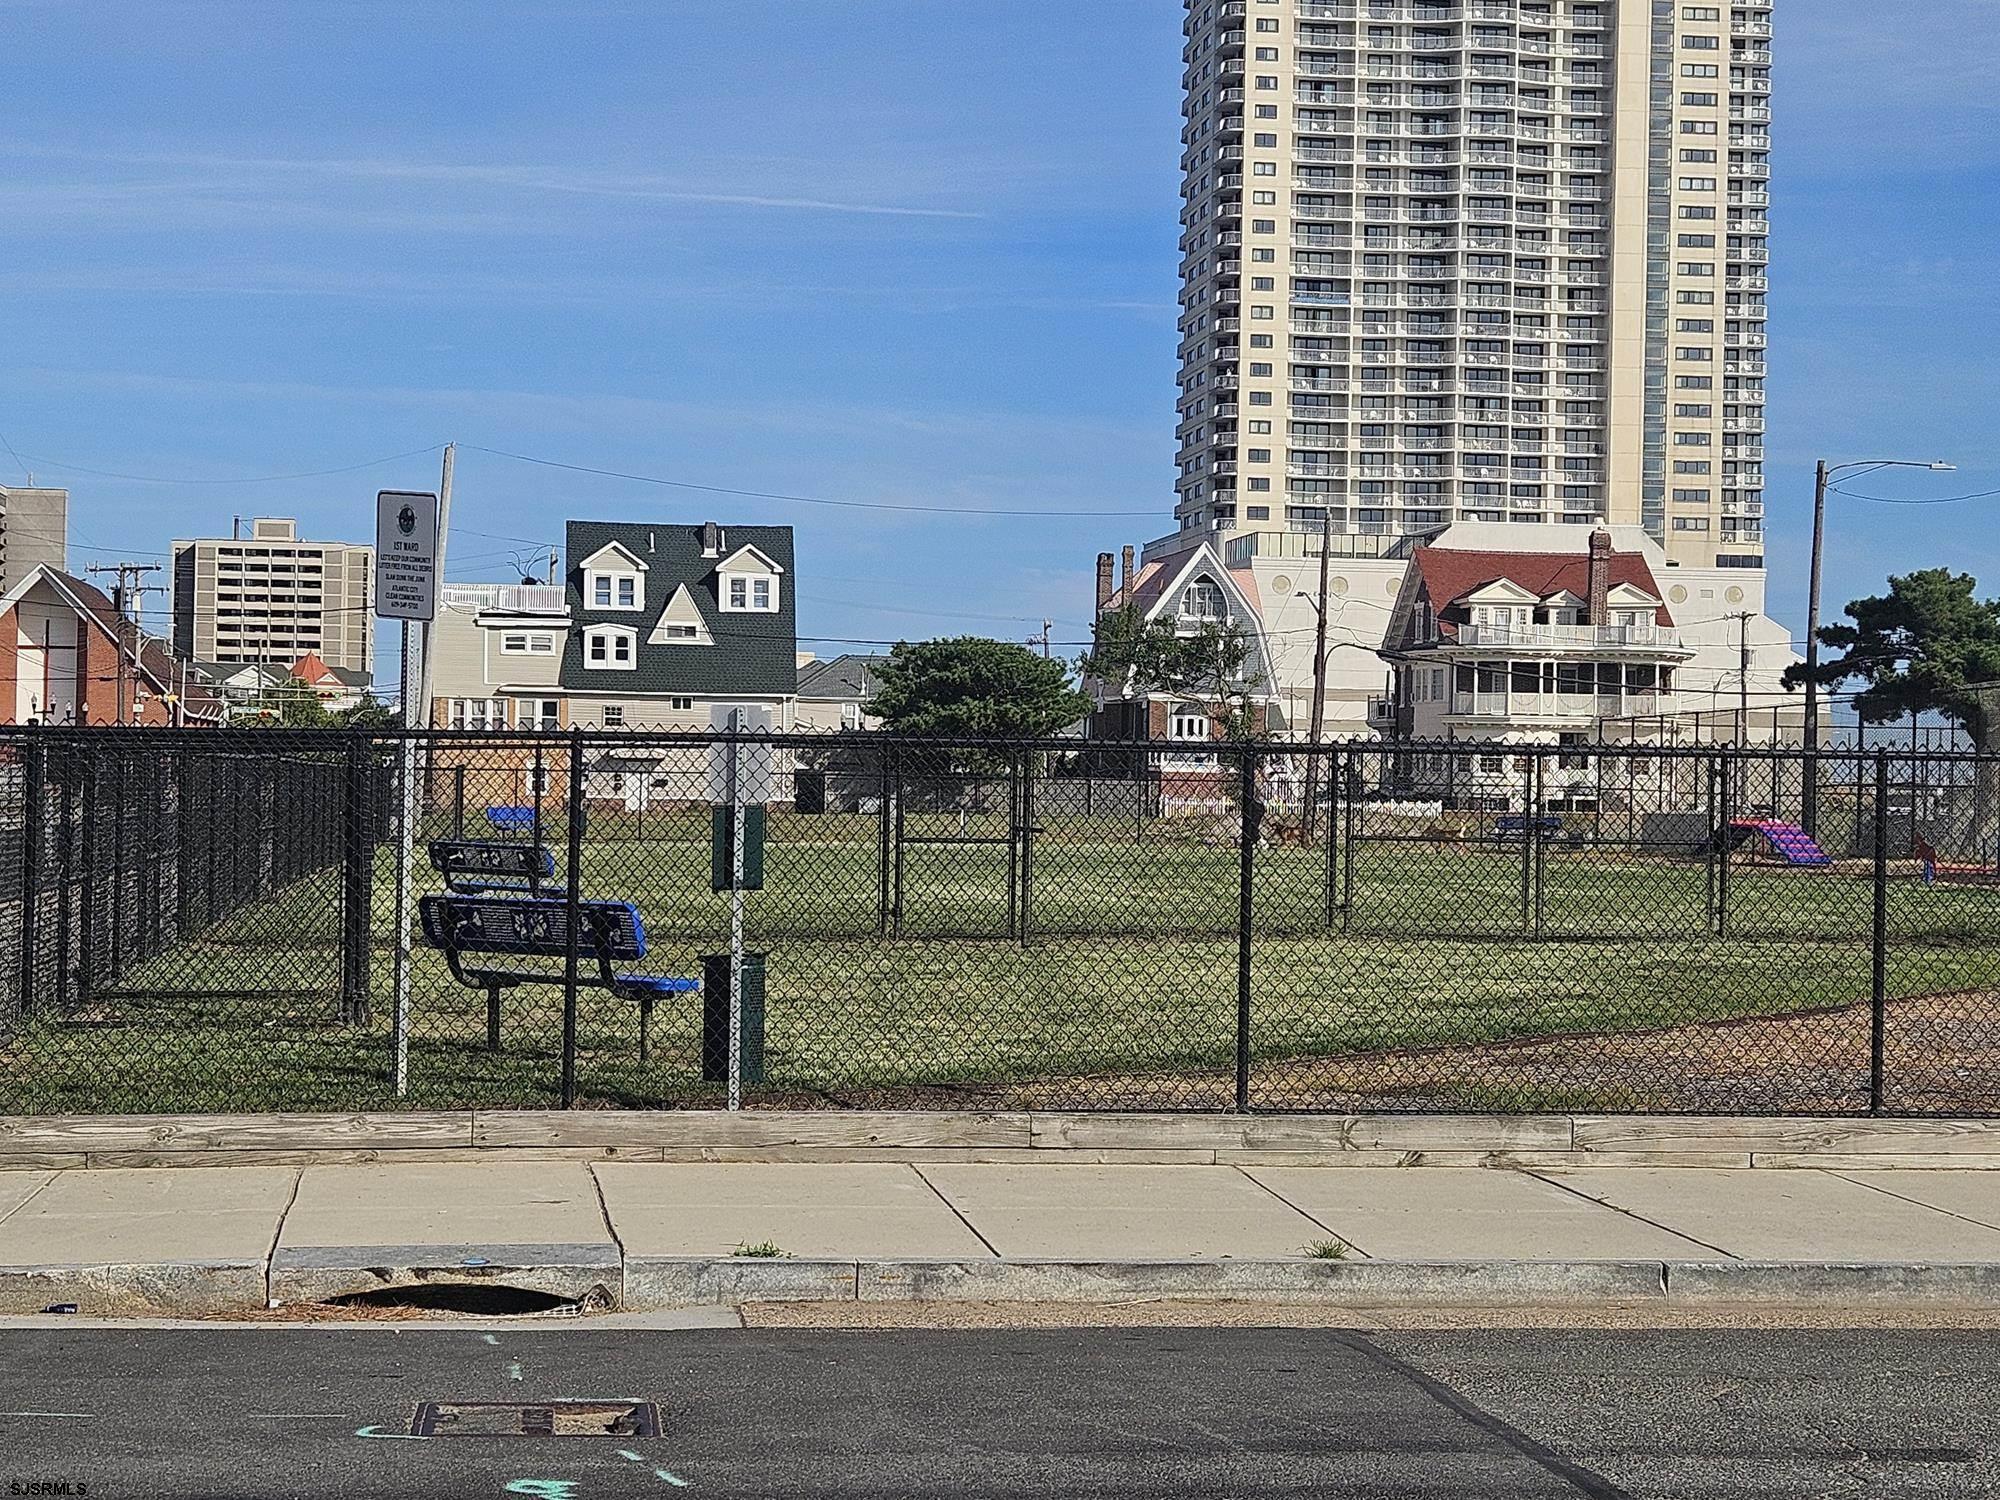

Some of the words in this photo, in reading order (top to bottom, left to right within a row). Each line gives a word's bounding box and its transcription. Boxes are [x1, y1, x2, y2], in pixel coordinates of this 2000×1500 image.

[394, 541, 402, 551] 1ST
[403, 542, 419, 552] WARD
[409, 556, 431, 564] COMMUNITY
[399, 594, 425, 602] COMMUNITIES
